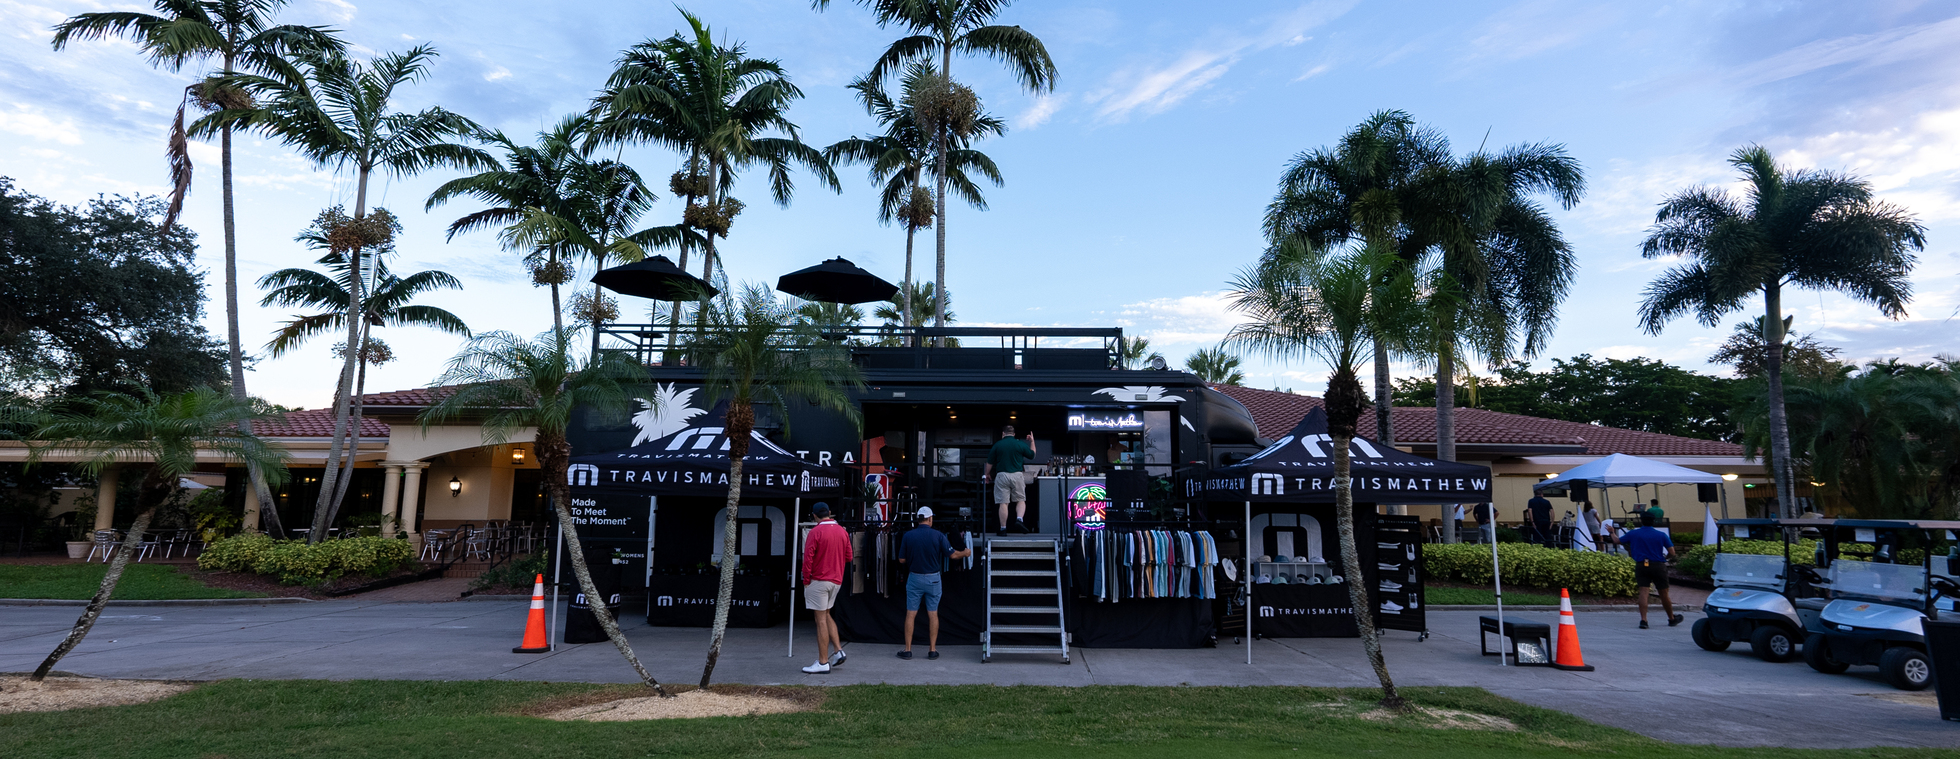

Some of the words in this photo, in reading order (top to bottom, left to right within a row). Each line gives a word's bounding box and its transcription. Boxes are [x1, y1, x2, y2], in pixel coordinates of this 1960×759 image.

[610, 470, 797, 486] TRAVISMAHEW
[571, 498, 596, 507] Made
[571, 507, 582, 516] To
[584, 508, 607, 516] Meet
[571, 517, 588, 525] The
[677, 597, 761, 607] TRAVISTHEW
[1278, 607, 1354, 615] TRAVISMATHE
